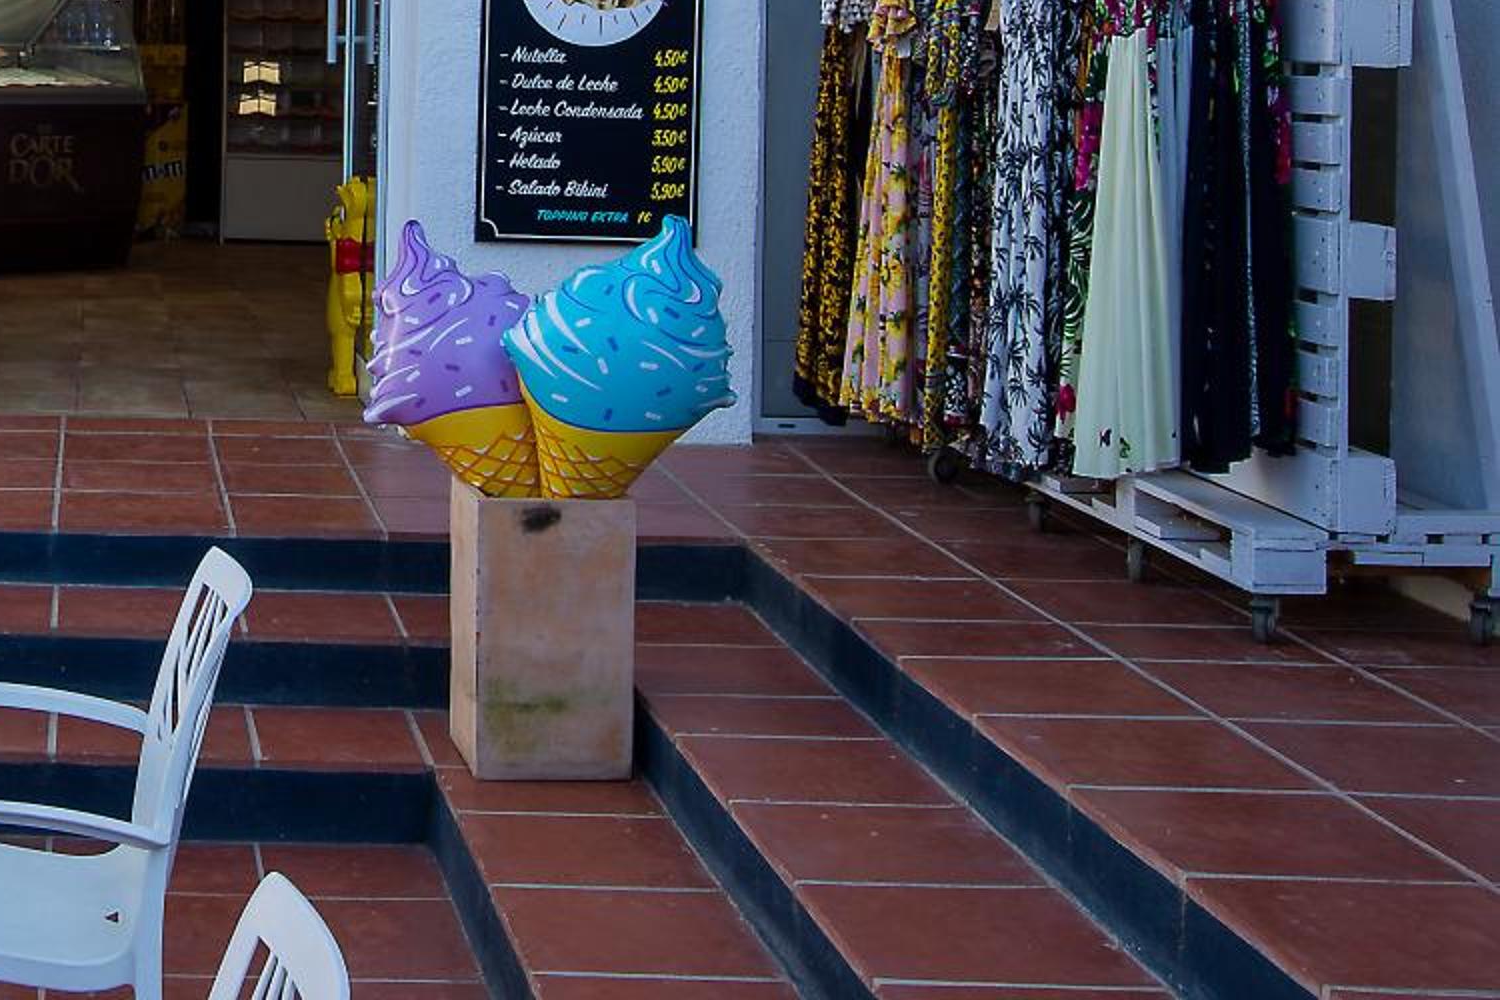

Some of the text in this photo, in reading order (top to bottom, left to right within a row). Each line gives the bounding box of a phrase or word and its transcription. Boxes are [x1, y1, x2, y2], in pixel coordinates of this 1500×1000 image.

[511, 45, 568, 65] Nutella
[511, 73, 553, 90] Dulce
[556, 74, 576, 91] de
[577, 74, 619, 93] Leche
[509, 98, 550, 117] Leche
[553, 100, 645, 120] Condensada
[509, 126, 563, 149] Azúcar
[509, 152, 561, 169] Helado
[507, 179, 561, 196] Salado
[563, 180, 609, 199] Bikini
[537, 209, 589, 223] TOPPING
[591, 211, 629, 223] EXTRA
